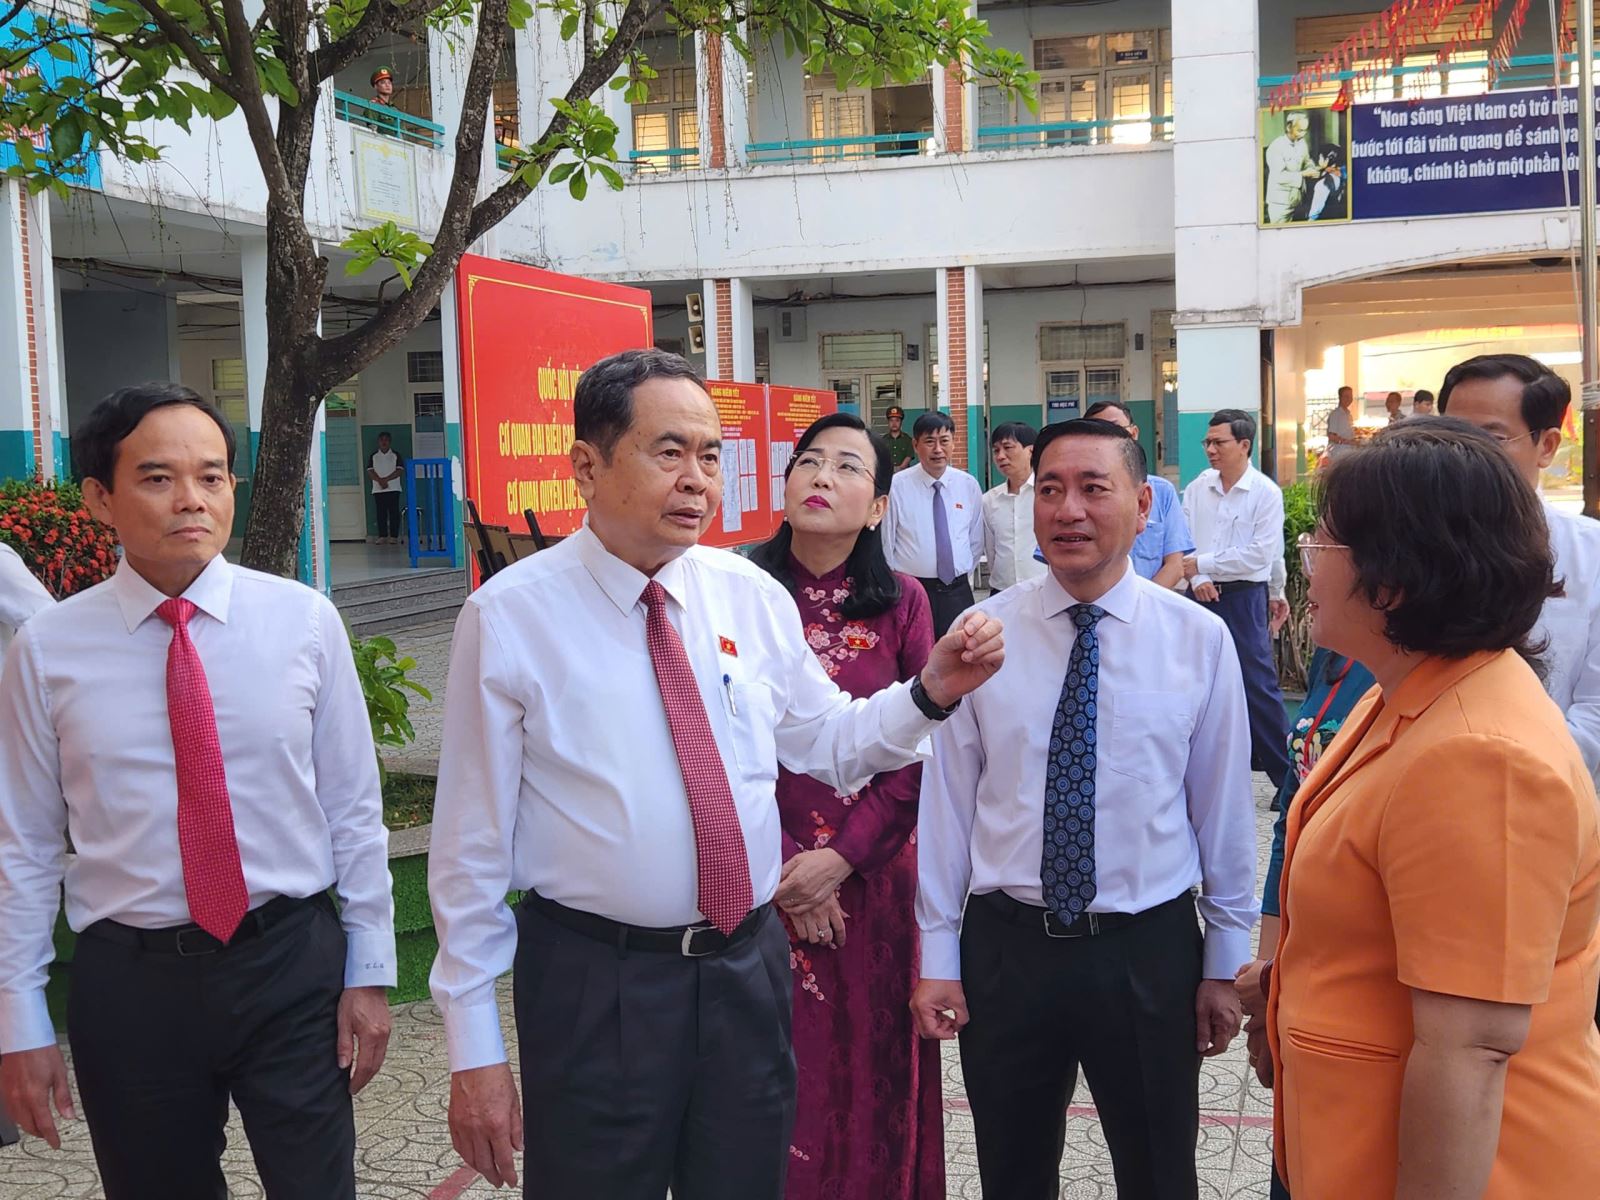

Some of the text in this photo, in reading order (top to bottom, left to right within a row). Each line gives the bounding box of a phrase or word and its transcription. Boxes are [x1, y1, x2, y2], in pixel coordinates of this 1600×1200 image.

[1410, 107, 1443, 125] sông
[1446, 104, 1472, 125] Việt
[1474, 103, 1507, 120] Nam
[1509, 100, 1527, 118] có
[1529, 96, 1550, 116] trở
[1552, 96, 1578, 115] nên
[1352, 138, 1384, 158] bước
[1385, 136, 1403, 156] tới
[1405, 135, 1427, 154] đài
[1429, 134, 1458, 153] vinh
[1460, 133, 1502, 152] quang
[1505, 124, 1523, 147] để
[1526, 126, 1560, 146] sánh
[1367, 165, 1413, 184] không,
[1414, 162, 1453, 181] chính
[1454, 160, 1468, 179] là
[1469, 158, 1495, 177] nhờ
[1497, 157, 1524, 178] một
[1525, 151, 1560, 176] phần
[538, 356, 557, 403] QUỐC
[558, 362, 570, 407] HỘI
[499, 419, 510, 456] CƠ
[511, 422, 531, 459] QUAN
[532, 423, 545, 463] ĐẠI
[545, 410, 562, 455] BIỂU
[507, 478, 518, 515] CƠ
[519, 480, 540, 517] QUAN
[540, 469, 563, 516] QUYỀN
[563, 475, 576, 517] LỰC
